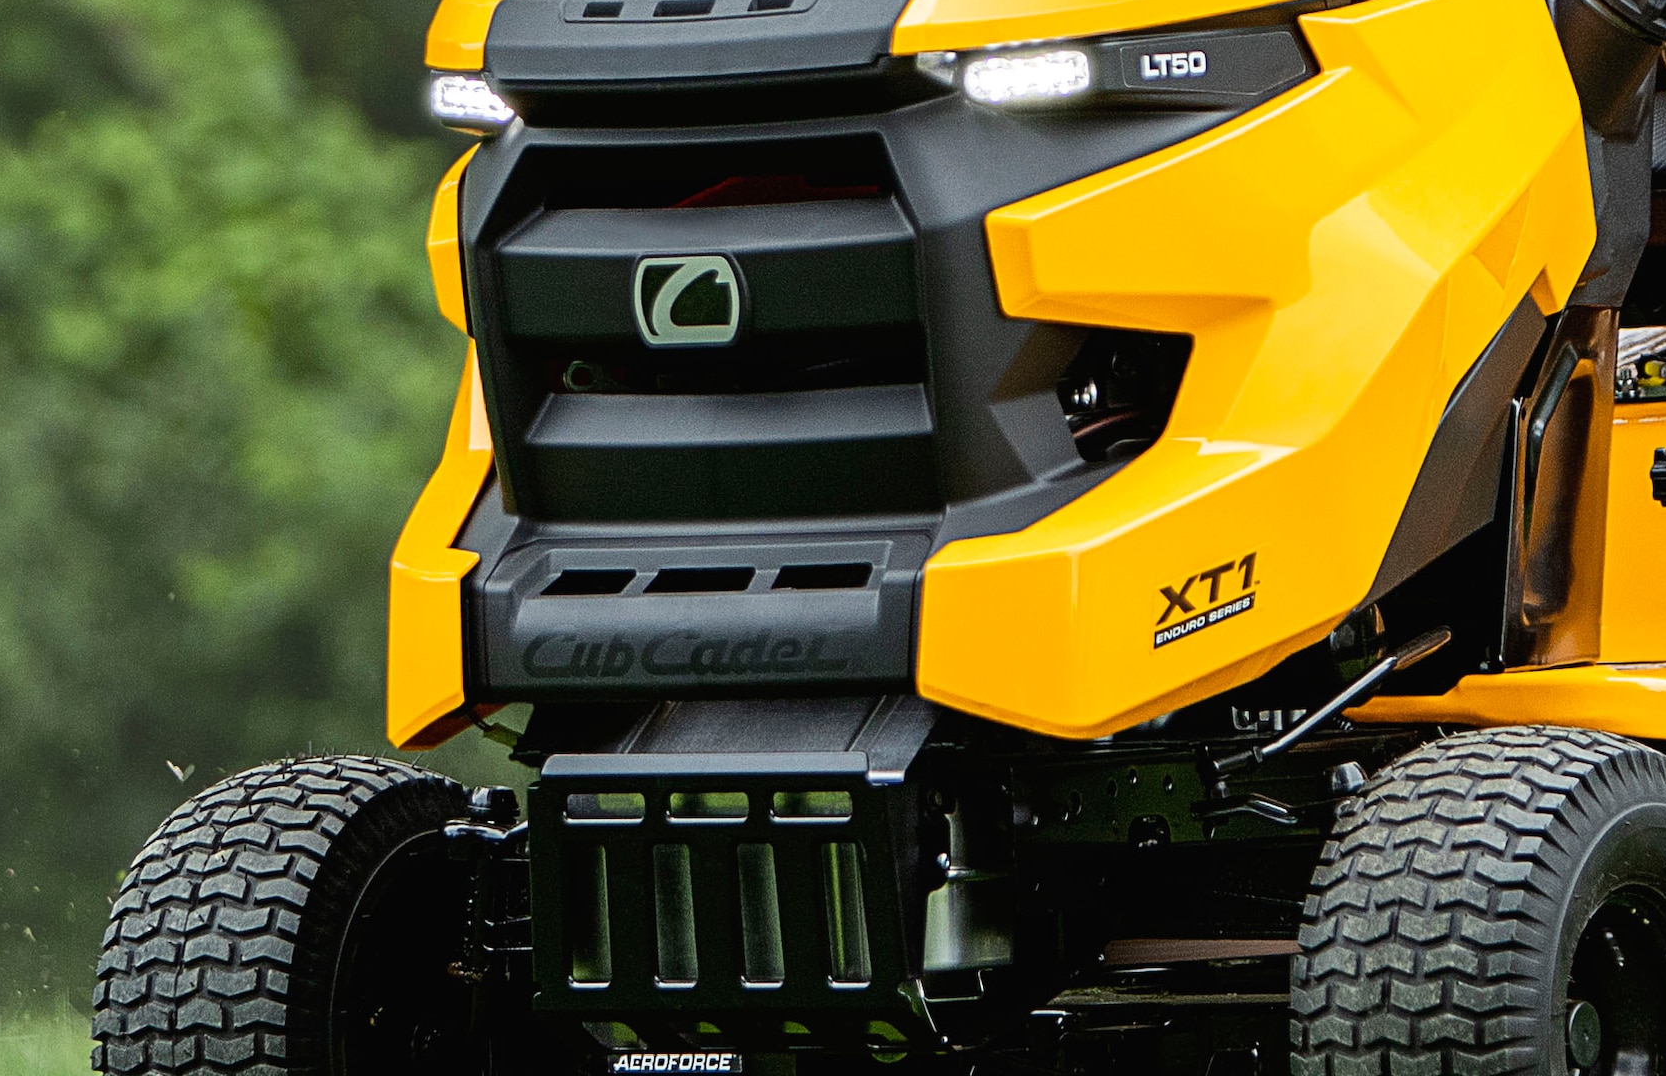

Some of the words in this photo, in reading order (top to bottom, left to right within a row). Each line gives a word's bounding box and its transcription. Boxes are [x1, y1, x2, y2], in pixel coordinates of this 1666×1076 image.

[1140, 50, 1207, 79] LT50
[1155, 551, 1257, 626] XT1
[1155, 616, 1205, 644] ENDURO
[1208, 597, 1251, 622] SERIES
[522, 632, 635, 678] Cub
[641, 630, 847, 675] Cadet
[613, 1053, 733, 1071] AEROFORCE
